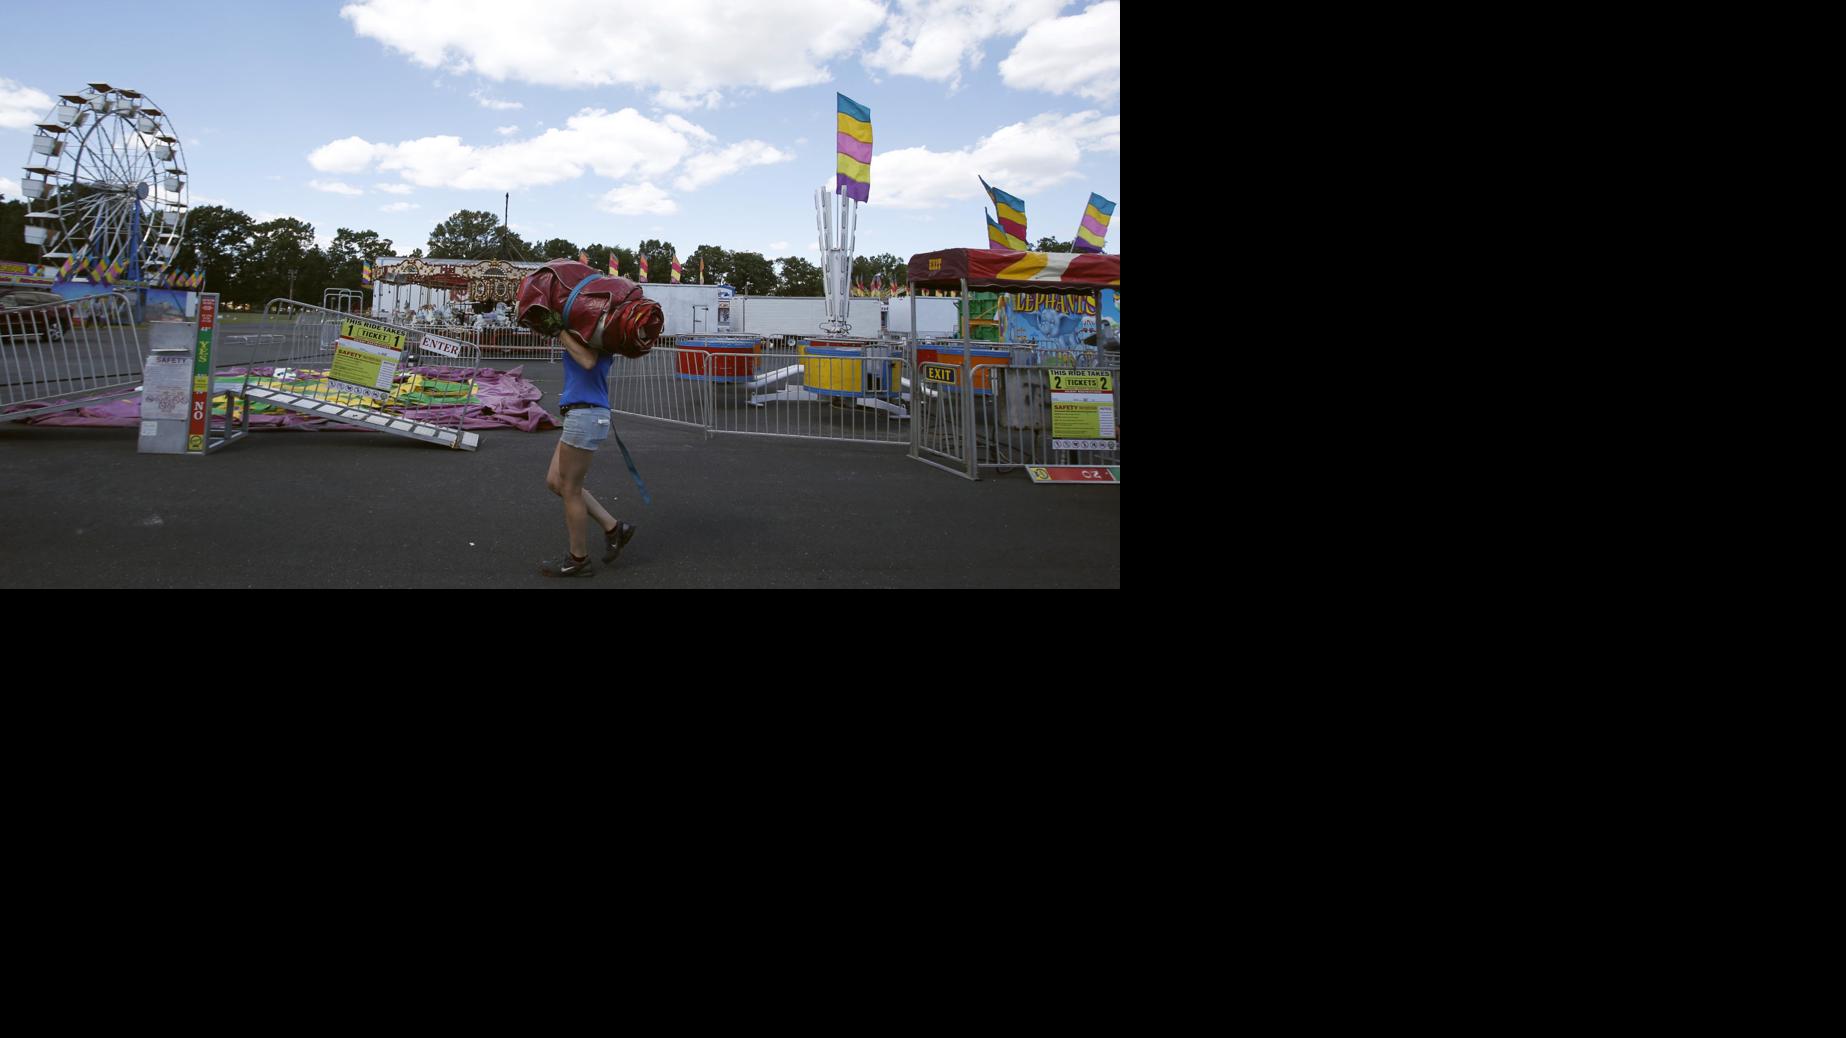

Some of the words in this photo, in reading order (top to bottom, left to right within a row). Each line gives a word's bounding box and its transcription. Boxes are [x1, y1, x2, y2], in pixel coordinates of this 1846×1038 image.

[929, 258, 942, 270] EXIT
[346, 317, 362, 326] THIS
[364, 322, 382, 330] RIDE
[384, 327, 406, 336] TAKES
[348, 325, 354, 336] 1
[362, 330, 387, 341] TICKET
[394, 336, 400, 347] 1
[199, 341, 208, 363] YES
[338, 349, 363, 359] SAFETY
[422, 337, 459, 355] ENTER
[929, 367, 951, 380] EXIT
[1054, 376, 1062, 389] 2
[1100, 377, 1108, 390] 2
[194, 402, 204, 420] NO
